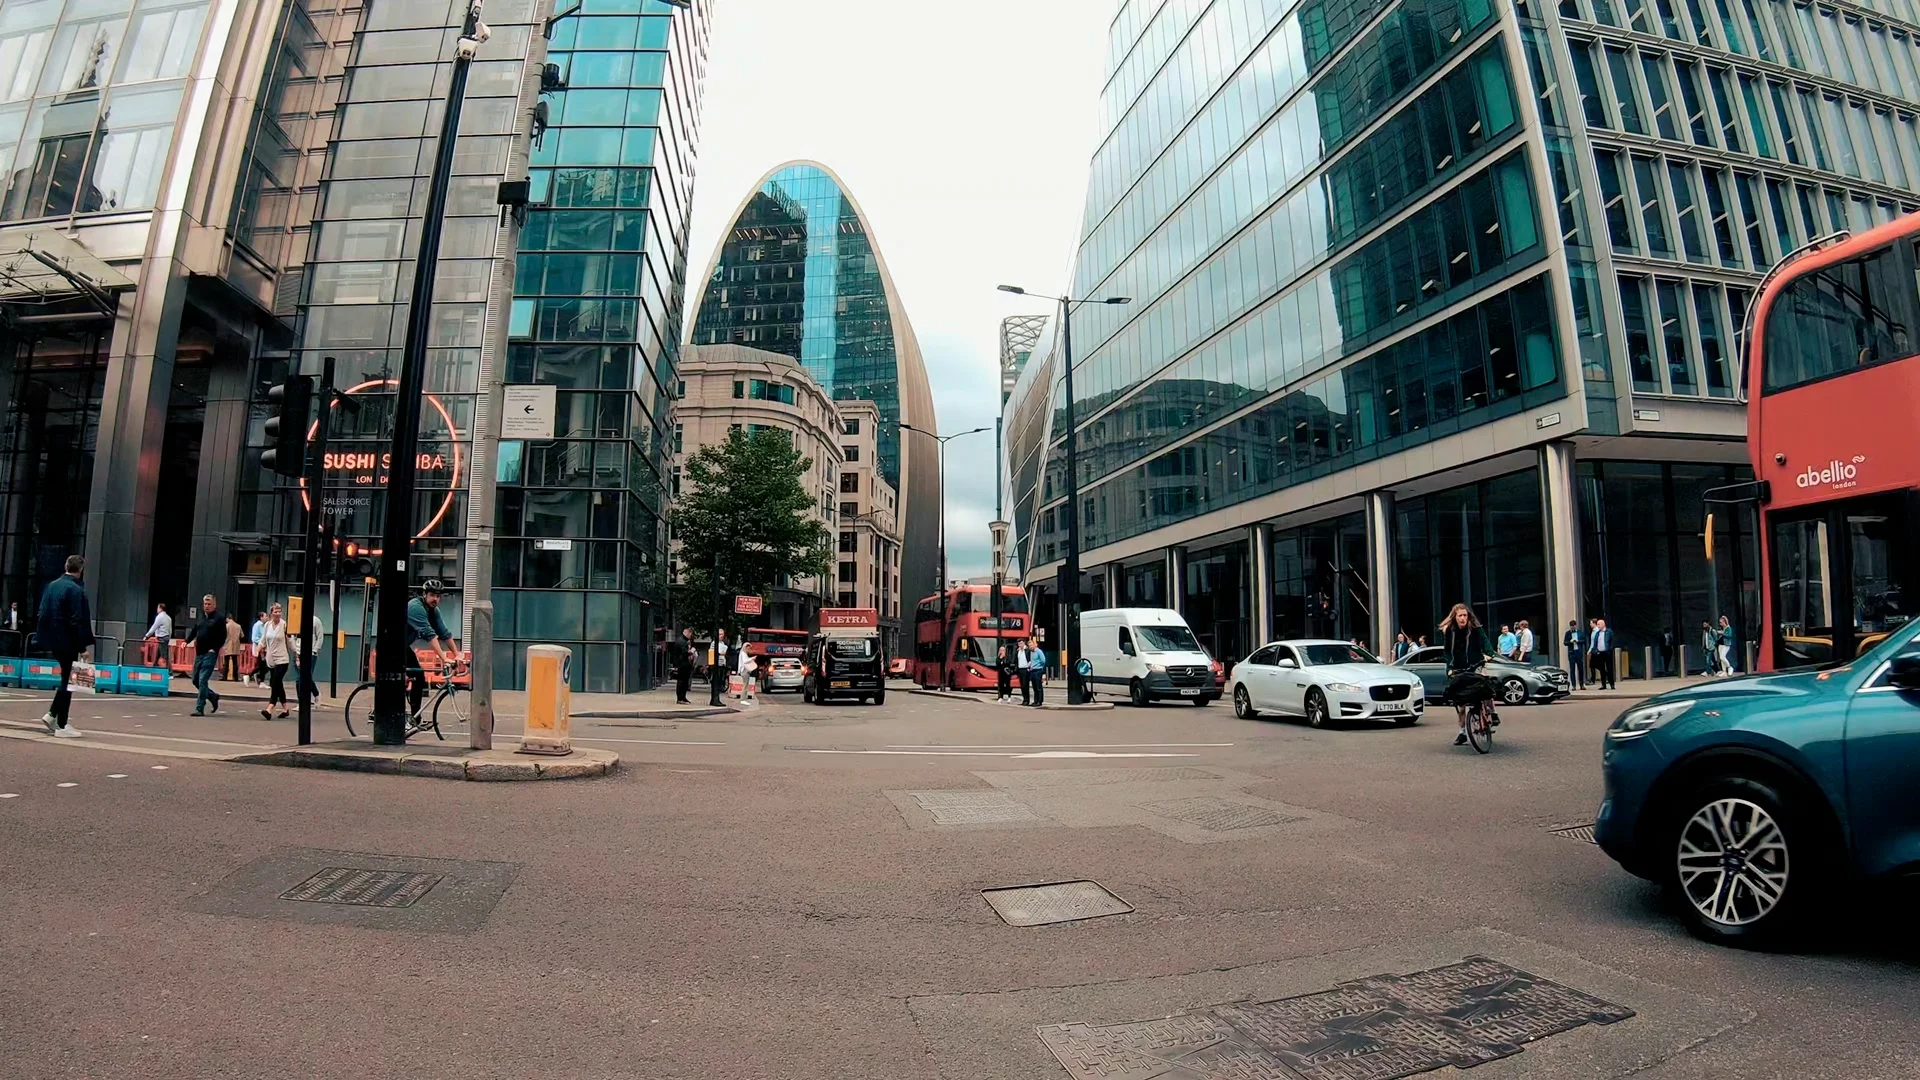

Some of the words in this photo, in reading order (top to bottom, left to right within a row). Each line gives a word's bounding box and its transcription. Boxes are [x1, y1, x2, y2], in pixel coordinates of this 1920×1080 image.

[323, 453, 375, 469] SUSHI
[381, 453, 443, 470] SBA
[1796, 460, 1857, 488] abellio
[355, 475, 373, 484] LON
[1832, 480, 1857, 490] london
[322, 498, 371, 506] SALESFORCE
[322, 507, 354, 515] TOWER
[827, 616, 869, 624] KETRA
[1011, 619, 1021, 627] 78
